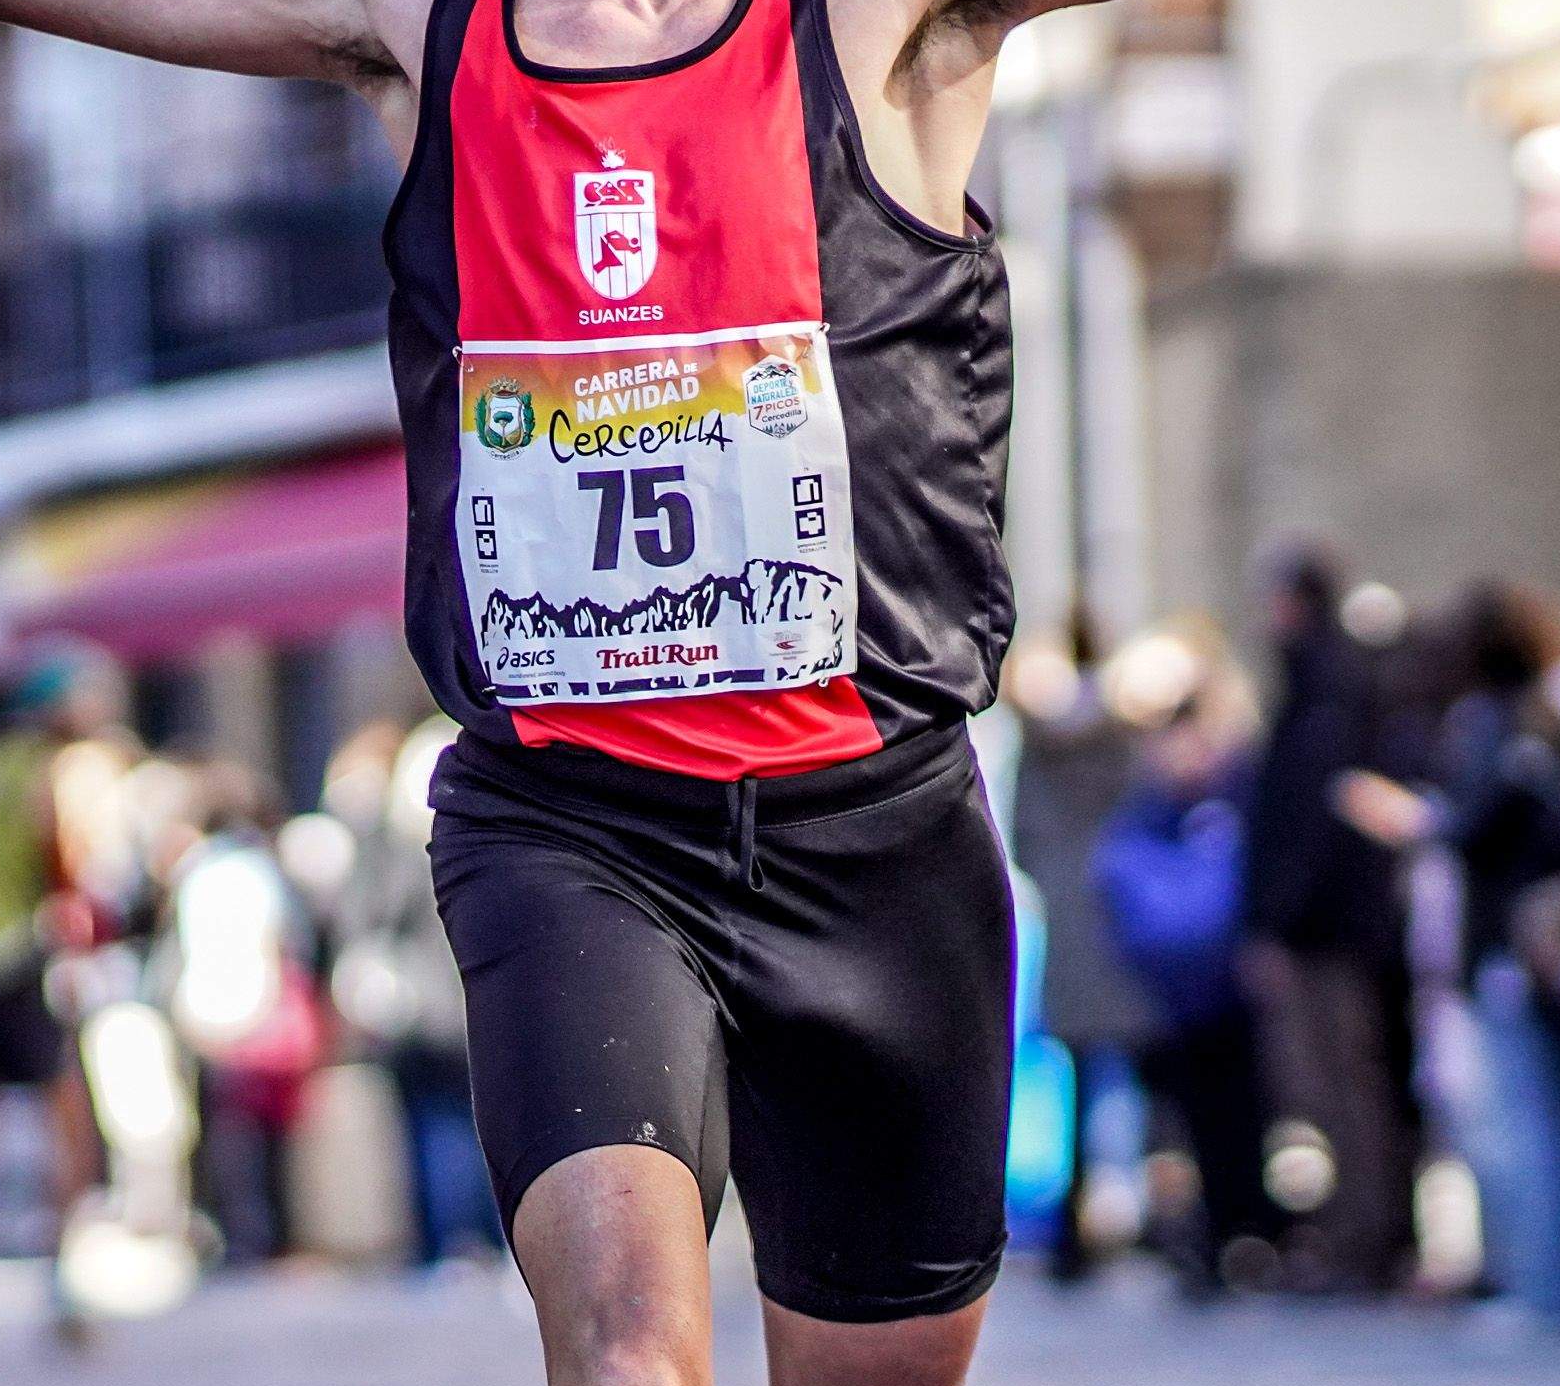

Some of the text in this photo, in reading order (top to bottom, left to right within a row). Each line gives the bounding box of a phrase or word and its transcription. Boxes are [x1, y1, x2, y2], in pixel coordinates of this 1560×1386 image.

[578, 305, 664, 325] SUANZES
[574, 358, 698, 397] CARRERA DE
[576, 376, 700, 423] NAVIDAD
[753, 397, 801, 420] 7 PICOS
[761, 409, 802, 423] Cercedilla
[577, 465, 695, 570] 75
[511, 649, 555, 668] asics
